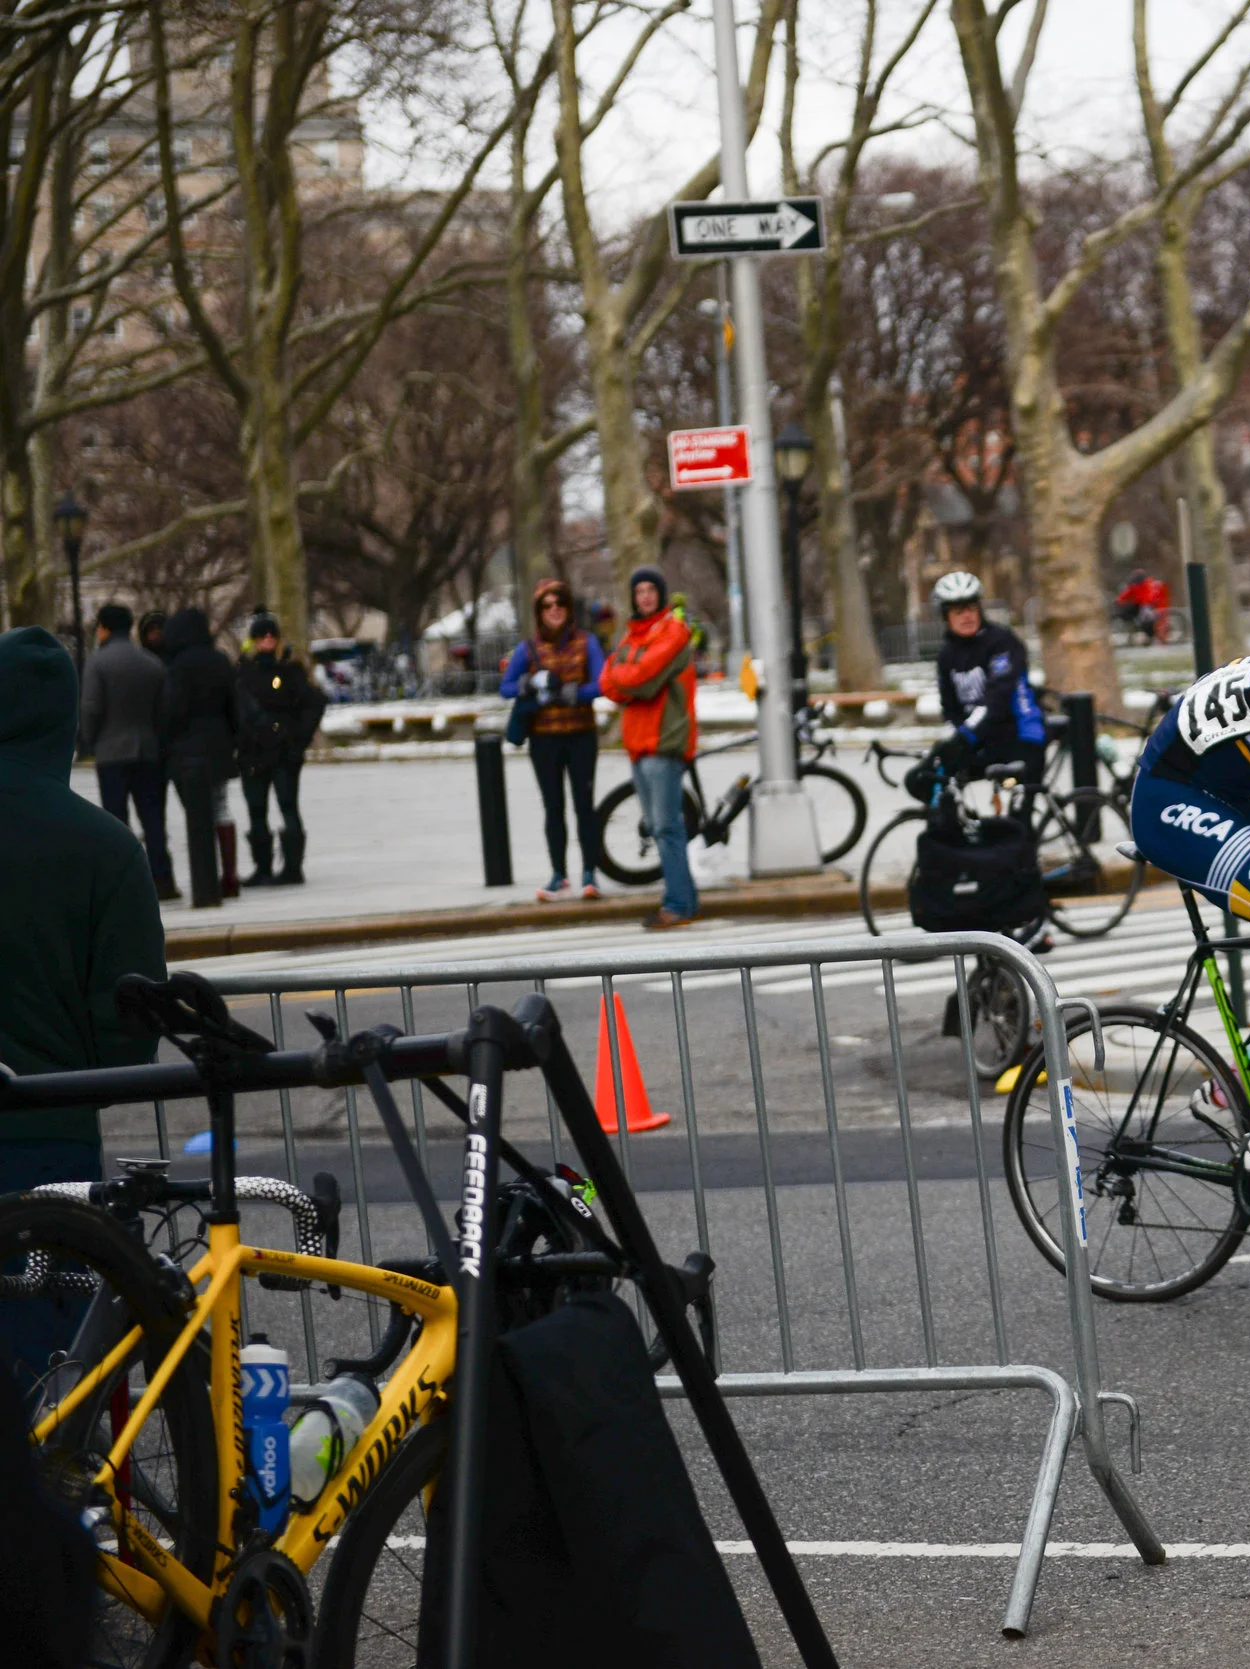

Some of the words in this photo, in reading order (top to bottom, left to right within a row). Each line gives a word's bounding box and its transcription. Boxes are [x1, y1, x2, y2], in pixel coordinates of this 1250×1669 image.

[695, 216, 738, 238] ONE
[758, 213, 800, 236] WAY
[1186, 673, 1248, 742] 145
[1160, 802, 1235, 842] CRCA
[458, 1133, 487, 1279] FEEDBACK
[313, 1363, 438, 1543] S-WORKS
